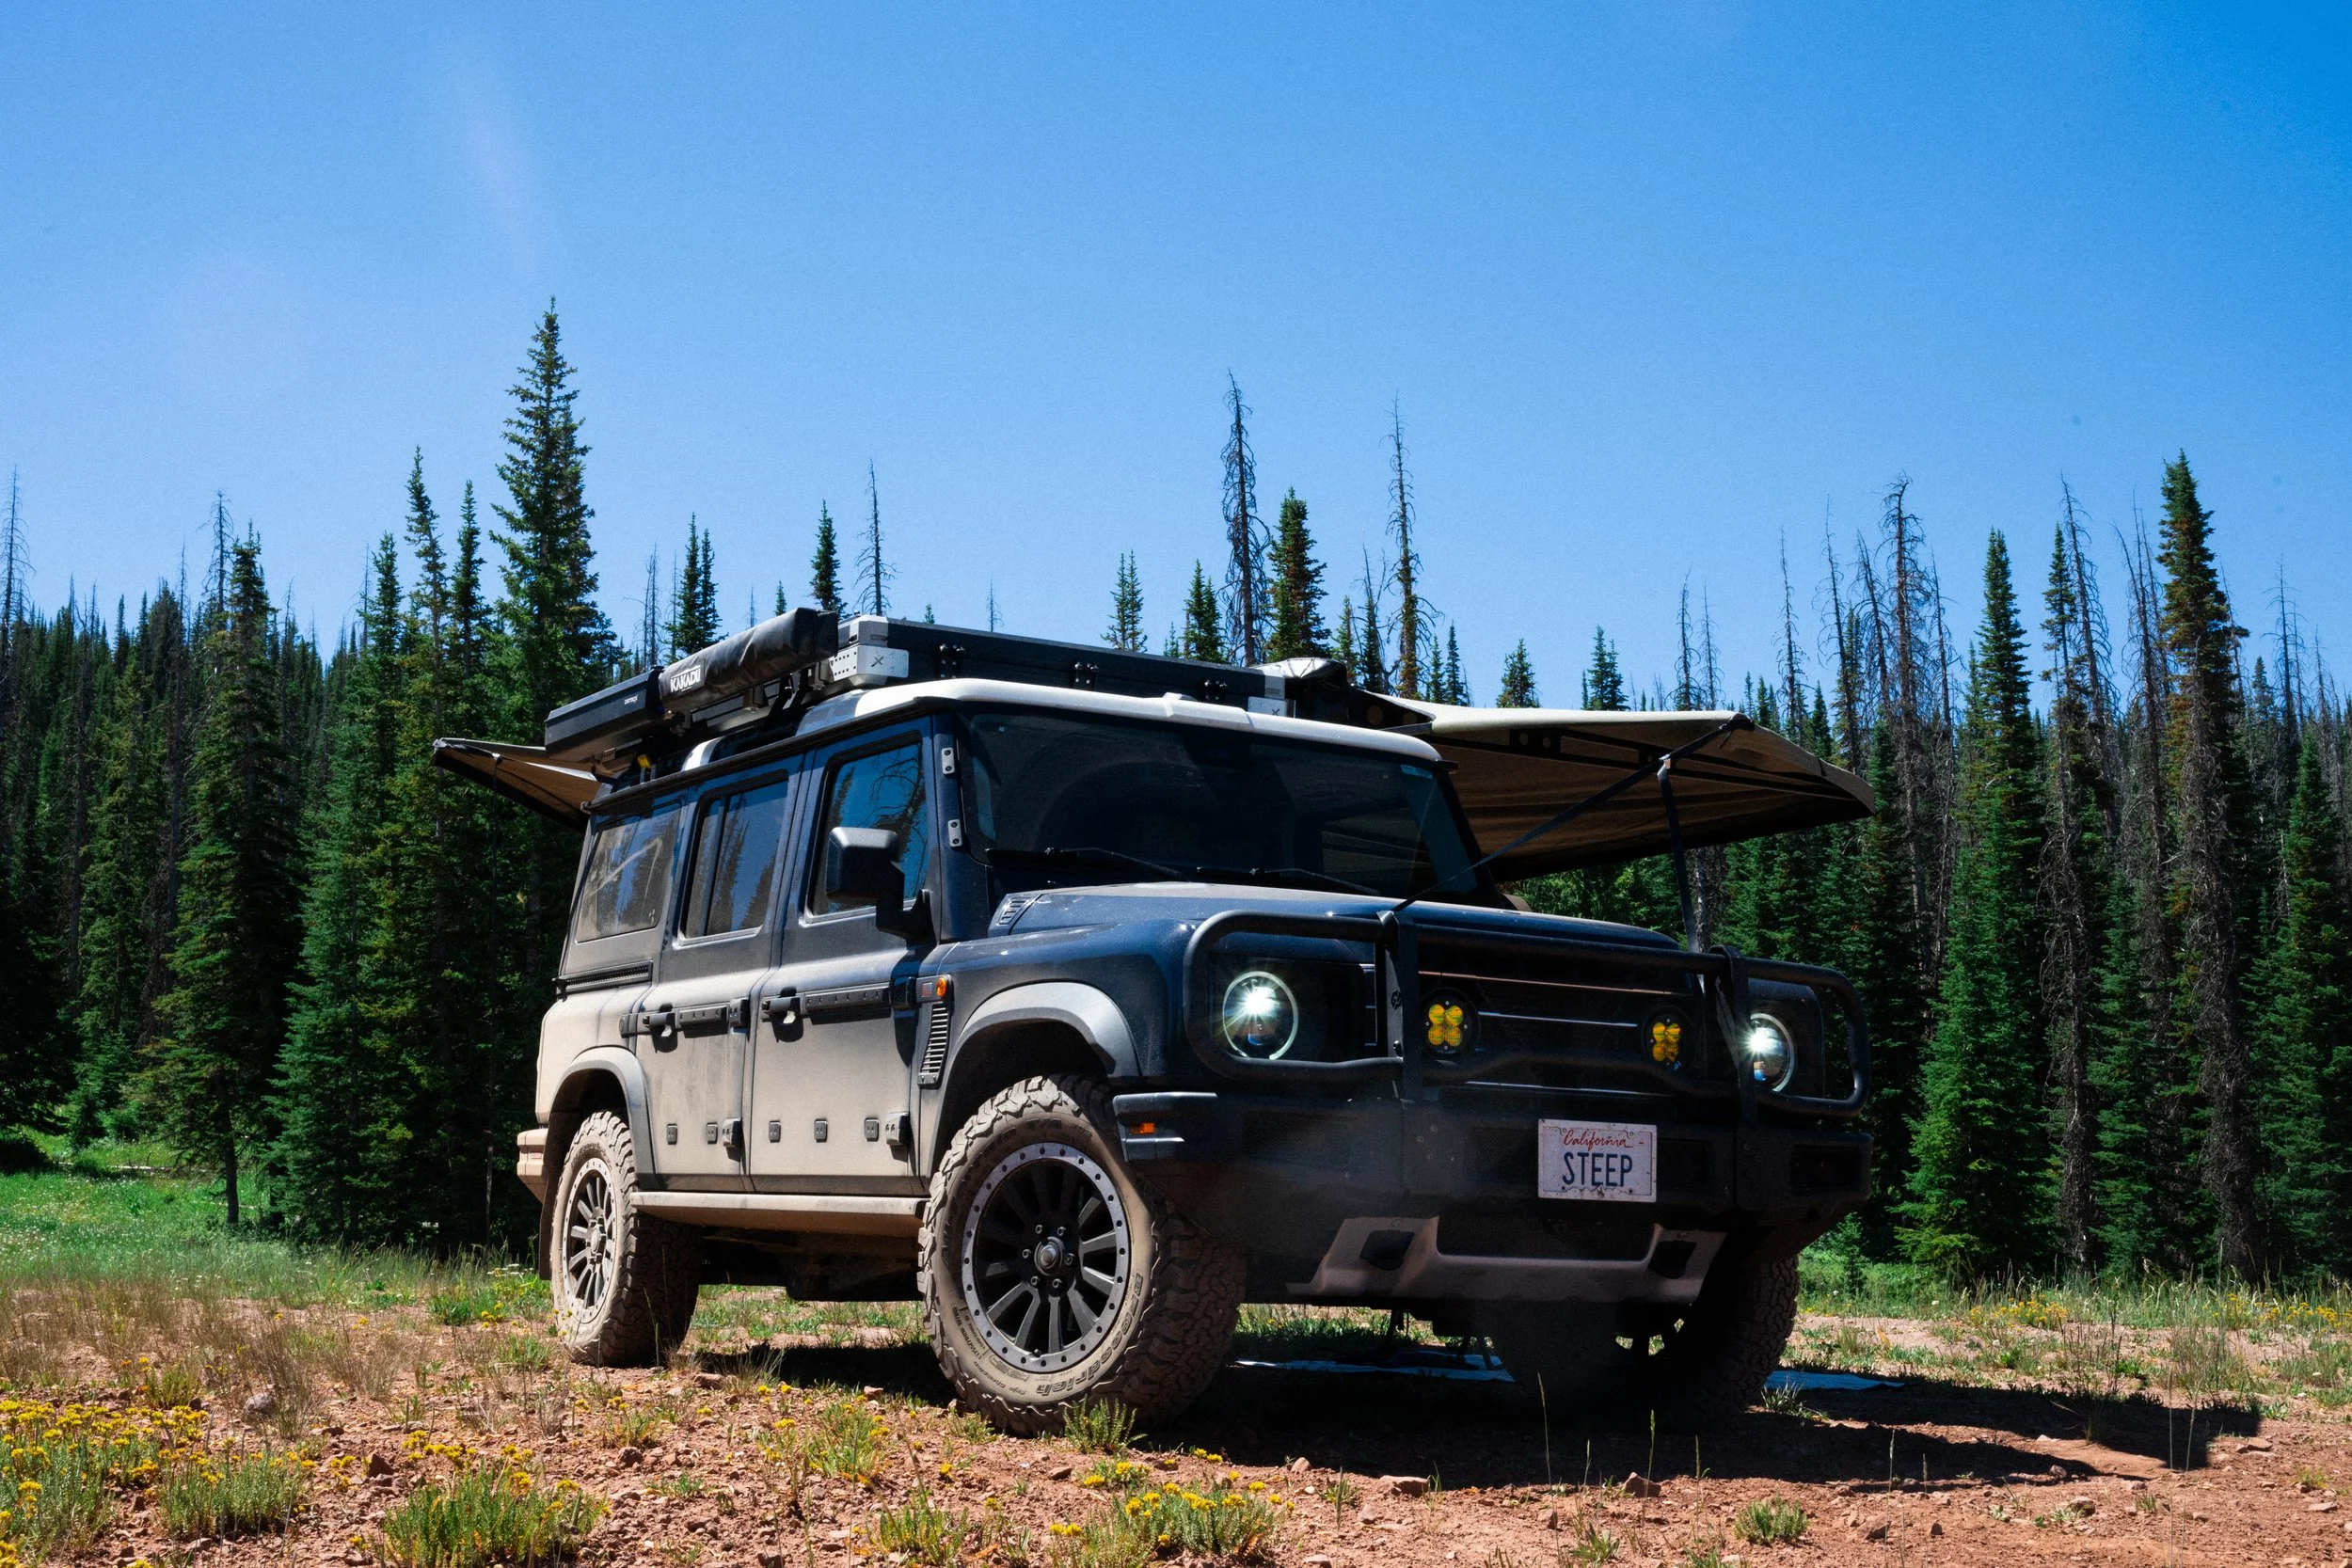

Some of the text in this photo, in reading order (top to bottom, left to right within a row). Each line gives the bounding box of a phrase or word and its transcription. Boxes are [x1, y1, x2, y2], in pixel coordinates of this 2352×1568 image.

[670, 667, 702, 693] KAKADU
[1563, 1129, 1634, 1151] California
[1562, 1151, 1633, 1187] STEEP
